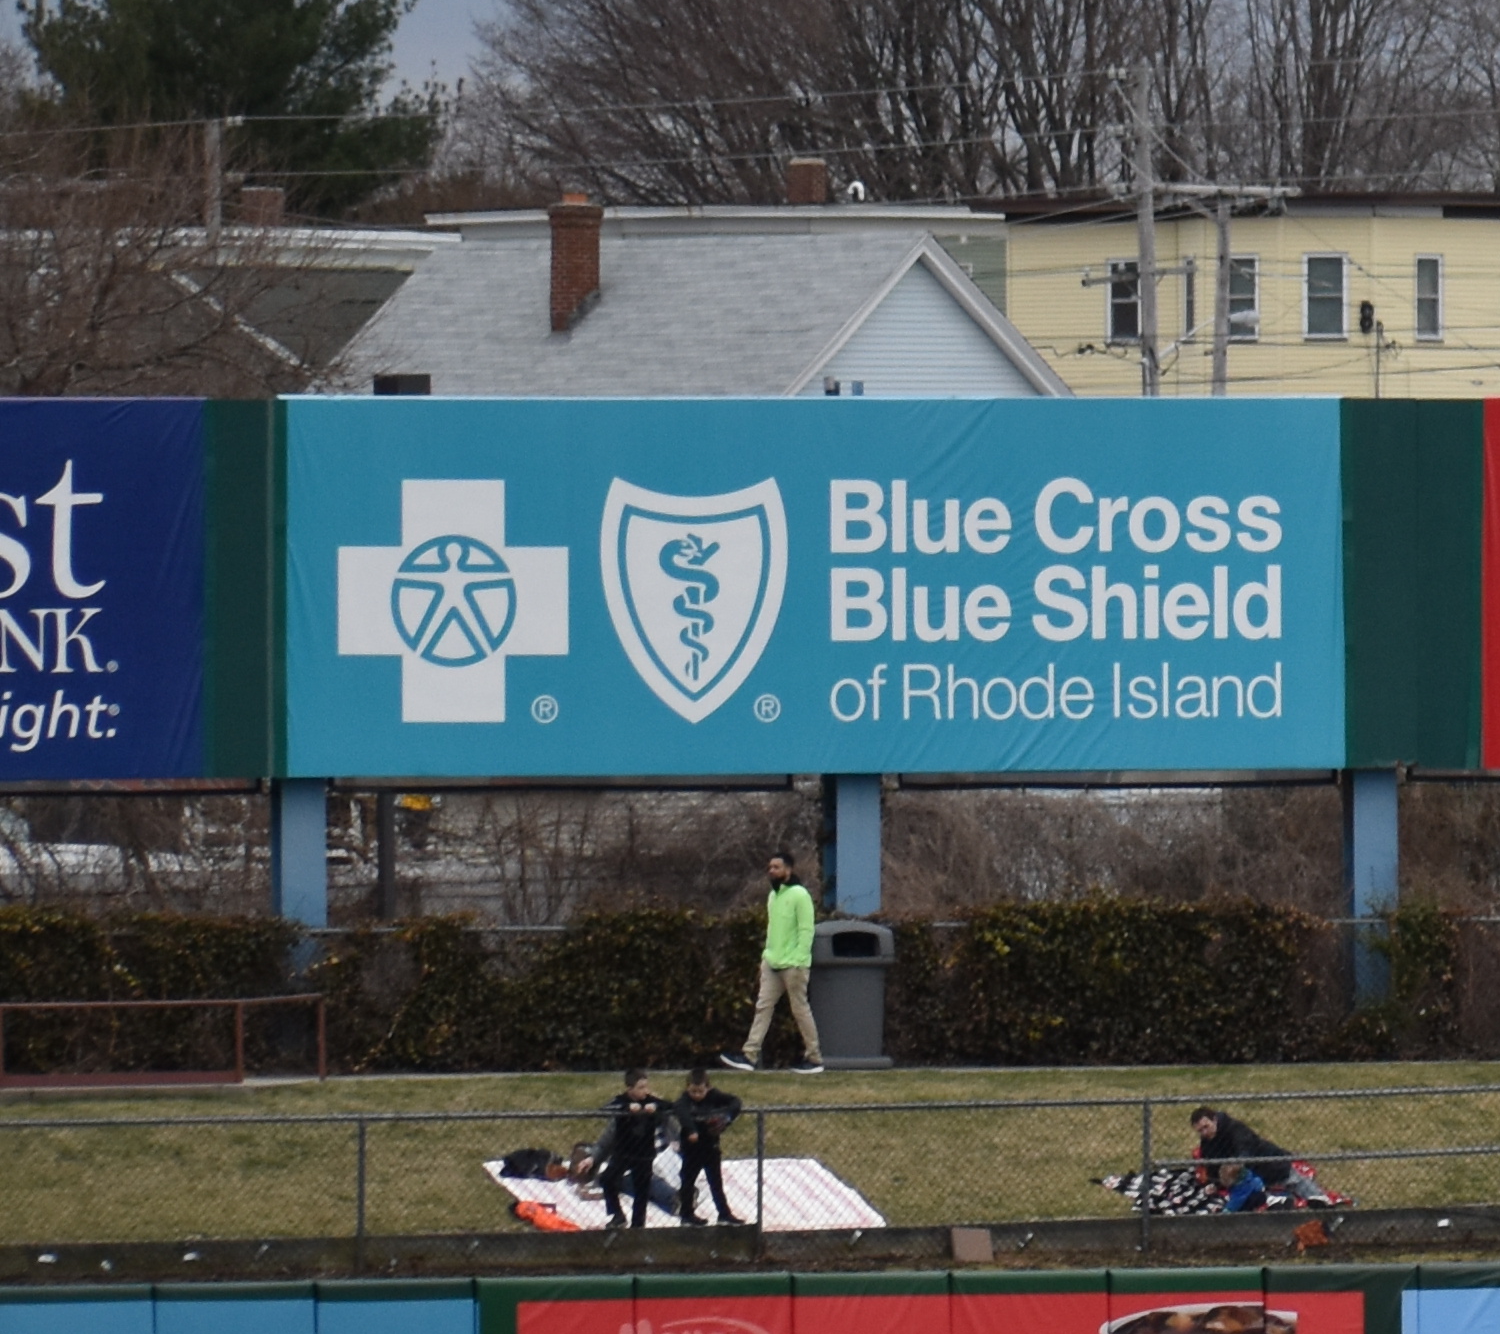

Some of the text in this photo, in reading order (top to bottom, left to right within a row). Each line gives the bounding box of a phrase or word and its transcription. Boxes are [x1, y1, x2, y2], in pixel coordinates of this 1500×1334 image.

[830, 477, 1282, 554] Blue Cross
[830, 564, 1282, 642] Blue Shield
[830, 661, 1282, 723] of Rhode Island
